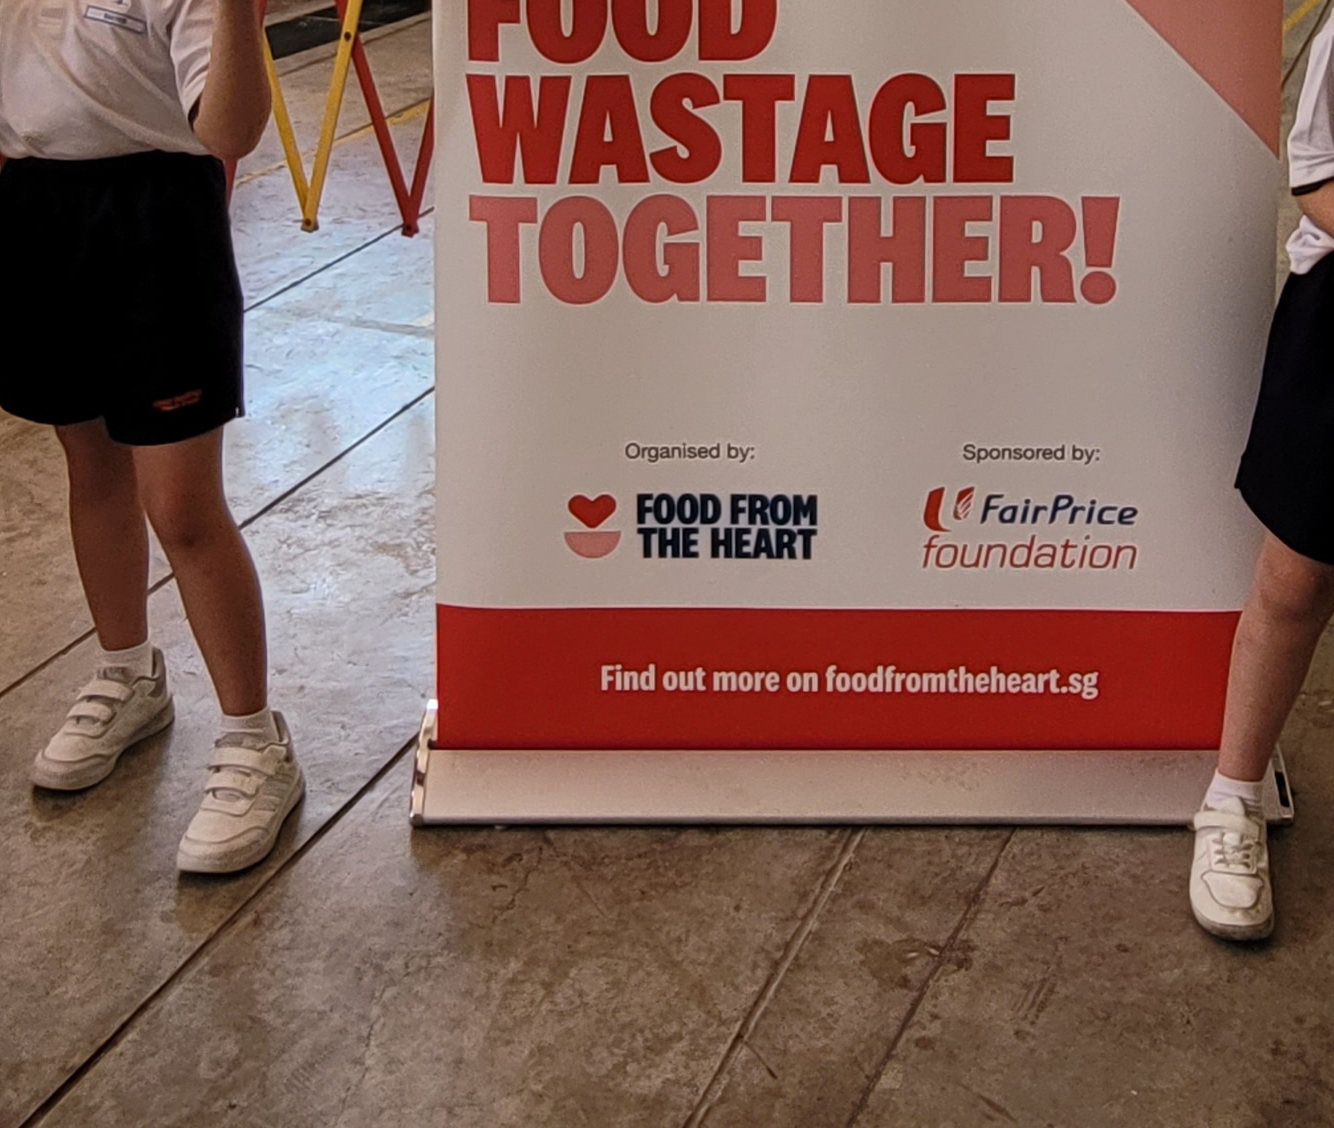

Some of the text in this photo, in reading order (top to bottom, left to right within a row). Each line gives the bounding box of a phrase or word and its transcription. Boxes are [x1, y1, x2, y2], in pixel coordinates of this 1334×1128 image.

[466, 73, 1015, 184] WASTAGE
[469, 194, 1119, 305] TOGETHER!
[624, 443, 755, 462] Organised by:
[962, 444, 1100, 463] Sponsored by:
[636, 493, 817, 525] FOOD FROM
[980, 494, 1138, 526] FairPrice
[637, 527, 817, 559] THE HEART
[922, 534, 1138, 569] foundation
[600, 665, 1098, 699] Find out more on foodfromtheheart.sg
